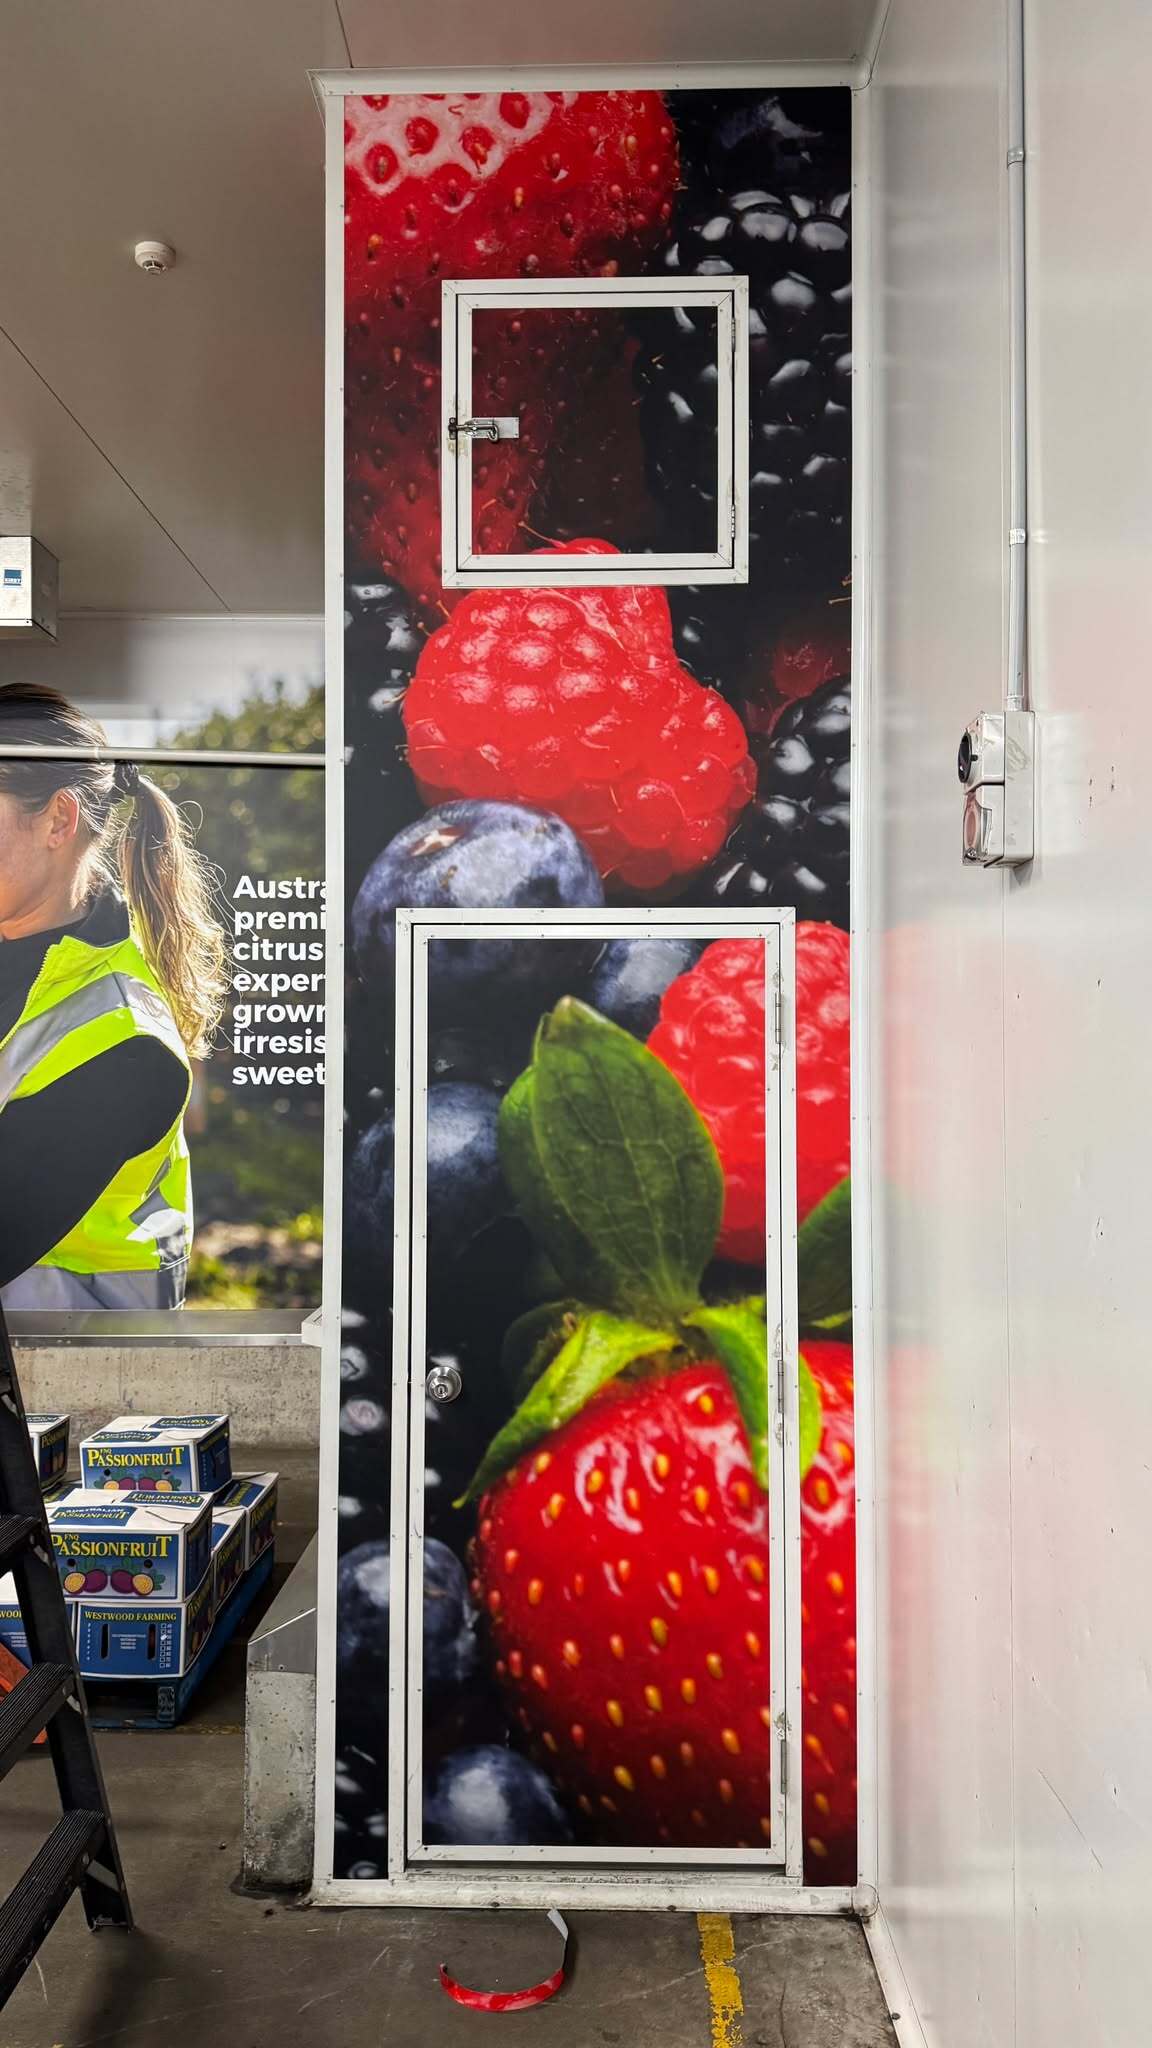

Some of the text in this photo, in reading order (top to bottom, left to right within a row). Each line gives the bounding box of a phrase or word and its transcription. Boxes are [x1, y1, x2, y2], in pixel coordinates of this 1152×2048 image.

[233, 935, 324, 961] citrus
[233, 972, 326, 998] exper
[87, 1446, 185, 1467] PASSIONFRUIT
[84, 1611, 177, 1620] WESTWOOD FARMING
